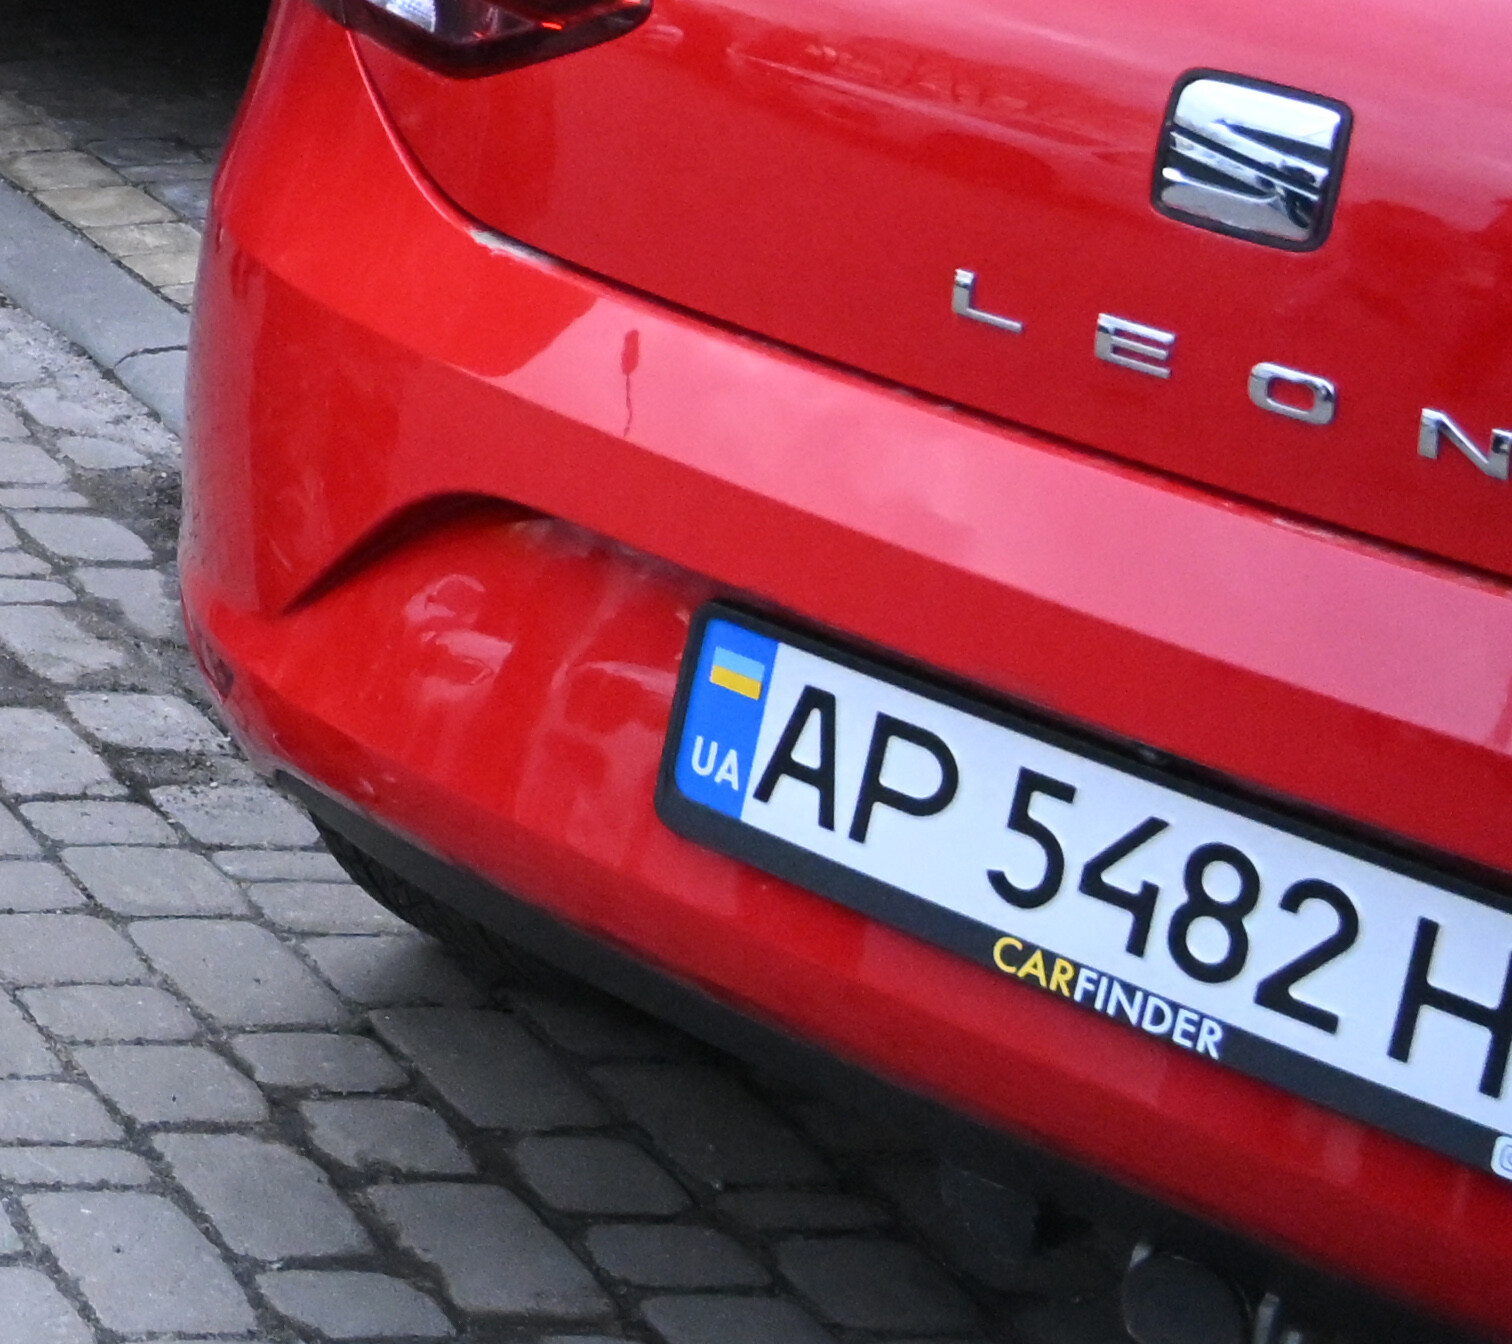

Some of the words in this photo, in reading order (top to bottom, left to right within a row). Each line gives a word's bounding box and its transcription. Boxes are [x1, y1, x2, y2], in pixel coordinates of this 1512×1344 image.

[951, 267, 1512, 481] LEON
[690, 734, 741, 792] UA
[752, 684, 960, 846] AP
[986, 766, 1361, 1035] 5482
[992, 935, 1225, 1061] CARFINDER
